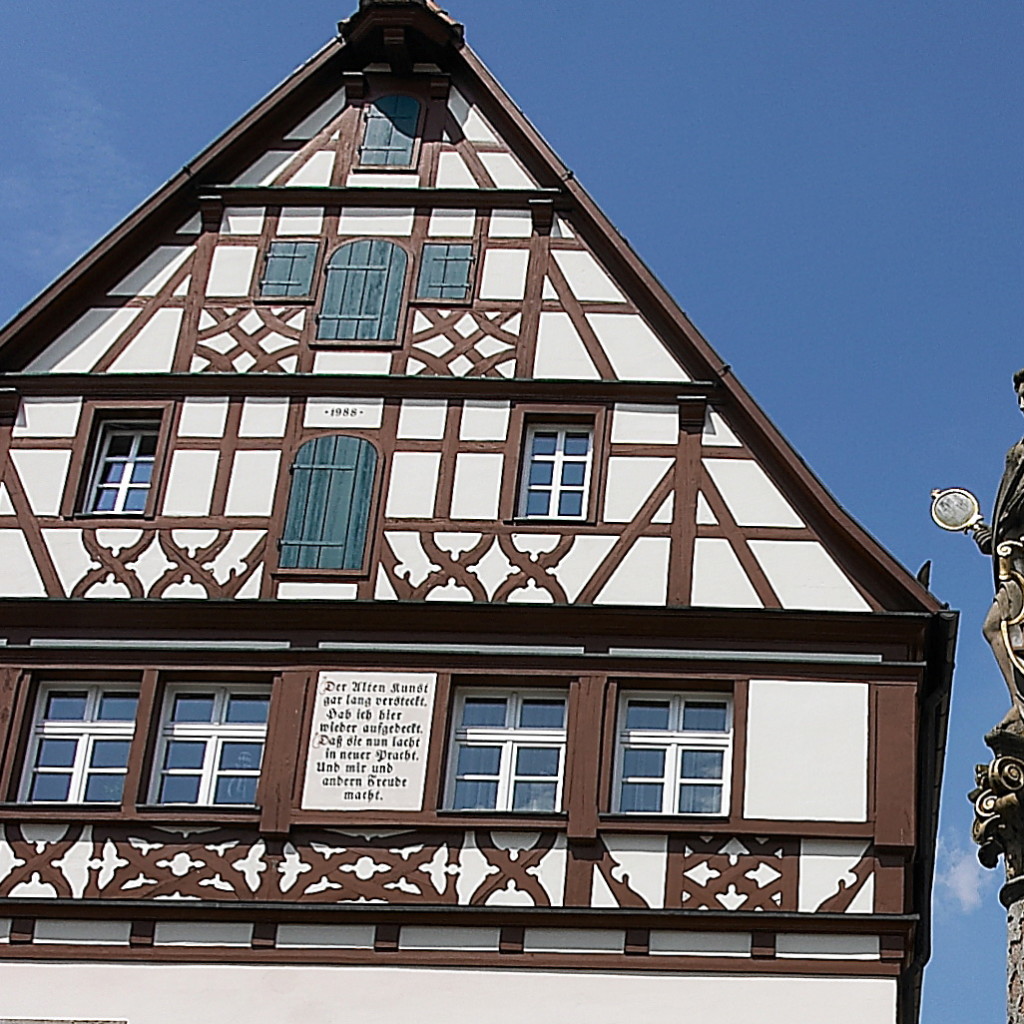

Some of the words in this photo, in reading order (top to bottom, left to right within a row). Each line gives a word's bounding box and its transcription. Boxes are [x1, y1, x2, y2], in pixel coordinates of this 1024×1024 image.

[320, 679, 347, 695] Der
[352, 681, 385, 692] Alten
[323, 697, 342, 707] gar
[346, 695, 371, 707] lang
[376, 696, 427, 707] versteckt.
[327, 708, 351, 720] Hab
[357, 708, 372, 720] ich
[320, 722, 357, 733] wieder
[363, 722, 423, 735] aufgedeckt.
[347, 735, 362, 746] sie
[366, 737, 387, 746] nun
[393, 735, 420, 748] lacht
[326, 748, 336, 759] in
[340, 751, 371, 759] neuer
[376, 750, 419, 762] Pracht.
[317, 762, 340, 773] Und
[346, 763, 367, 773] mir
[372, 764, 393, 773] und
[323, 776, 362, 786] andern
[344, 791, 383, 803] macht.
